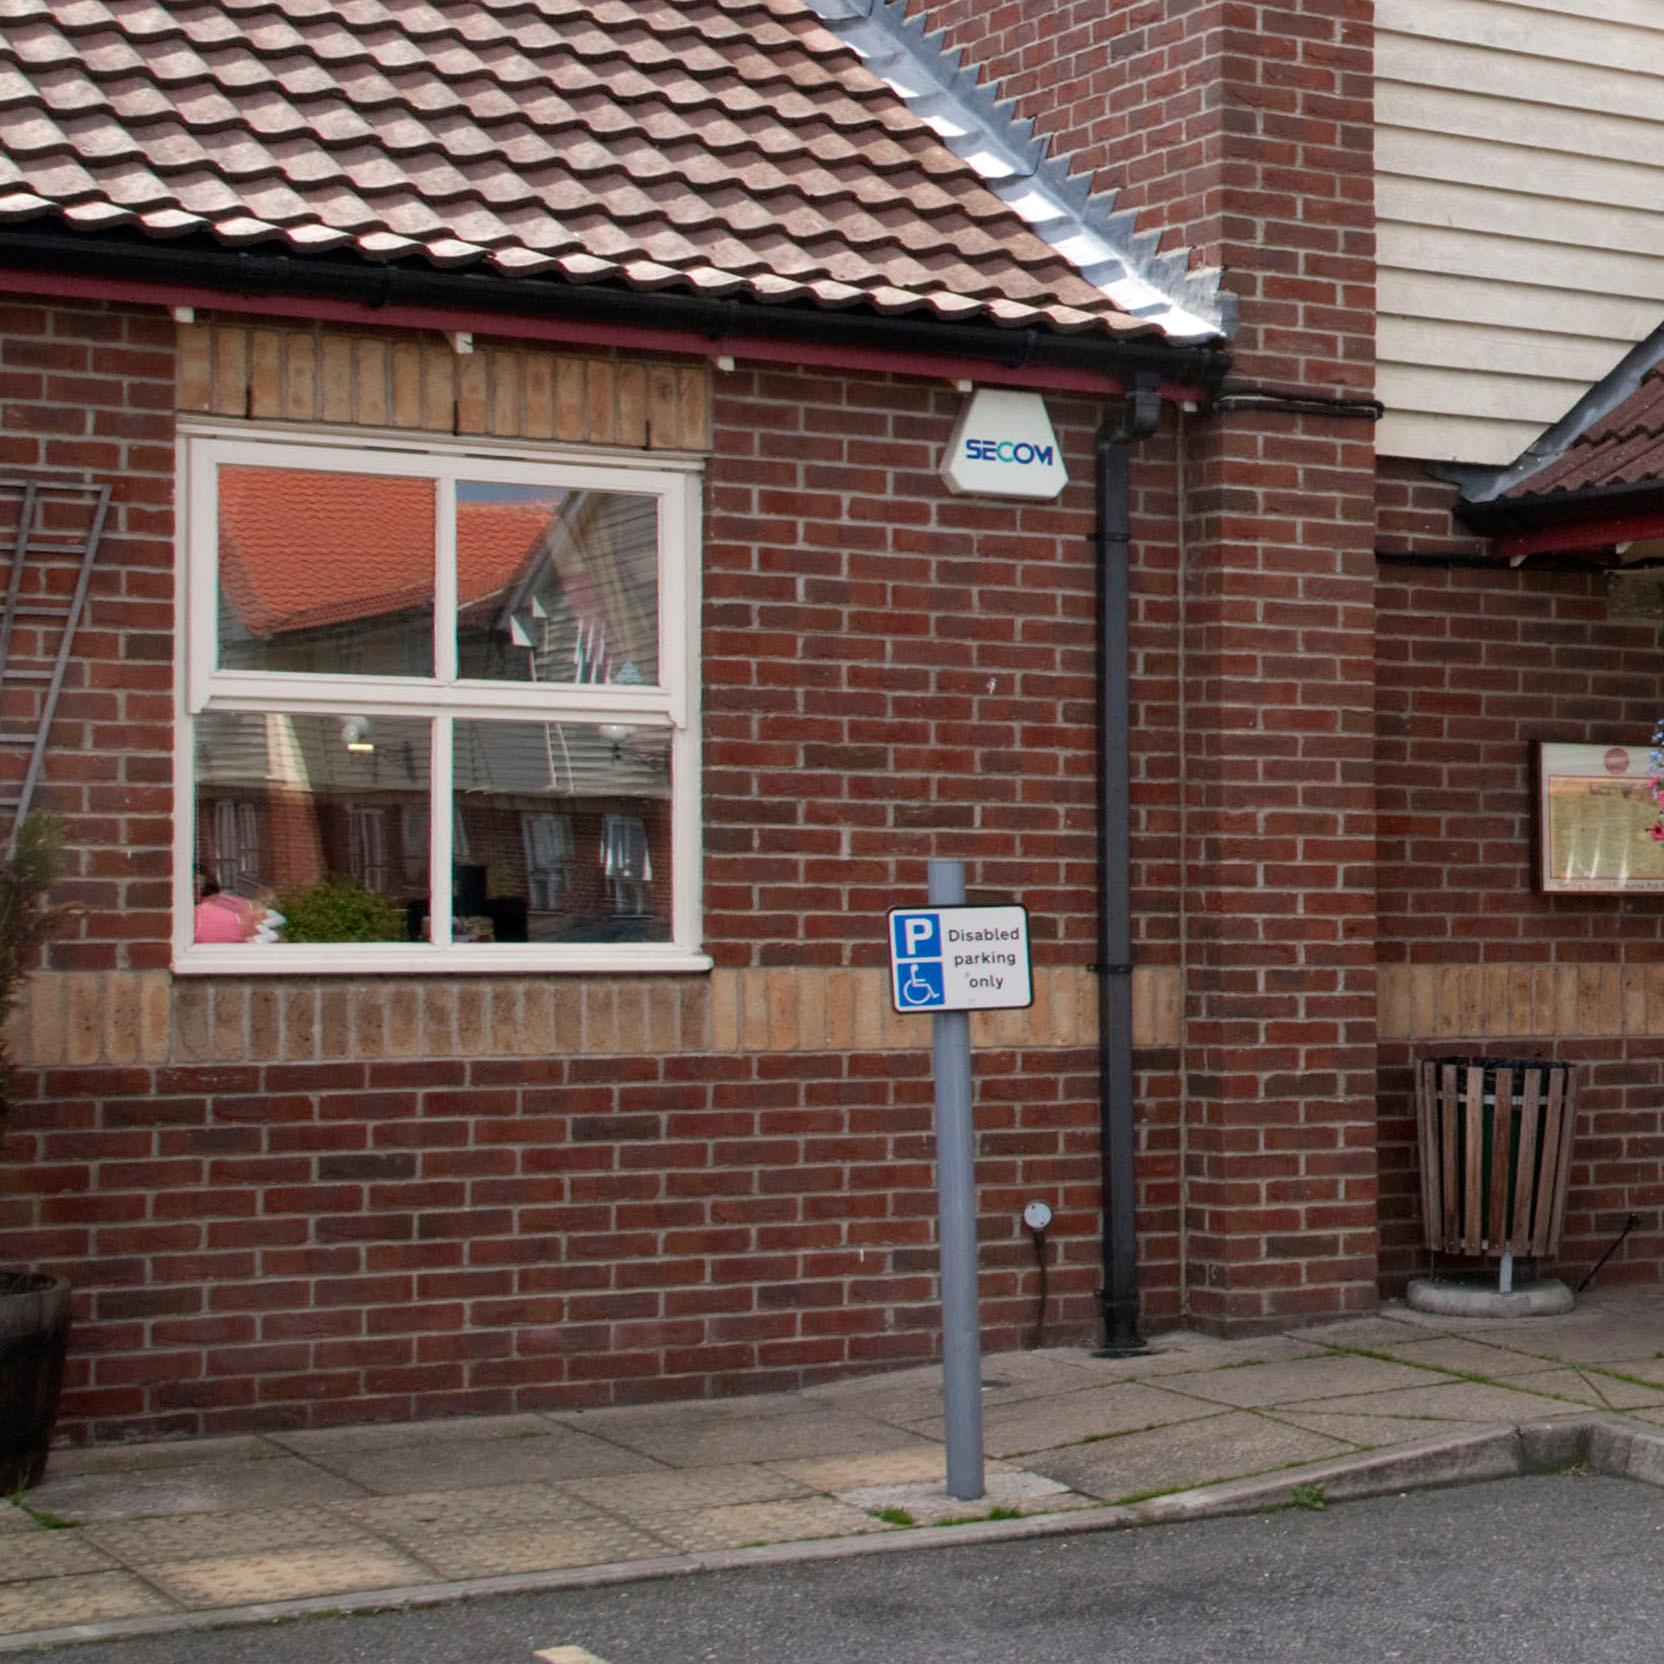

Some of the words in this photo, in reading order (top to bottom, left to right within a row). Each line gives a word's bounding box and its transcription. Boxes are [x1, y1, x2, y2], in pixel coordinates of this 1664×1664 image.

[966, 439, 1054, 466] SECOM
[904, 917, 933, 956] P
[948, 927, 1020, 943] Disabled
[954, 951, 1017, 967] parking
[969, 975, 1004, 989] only
